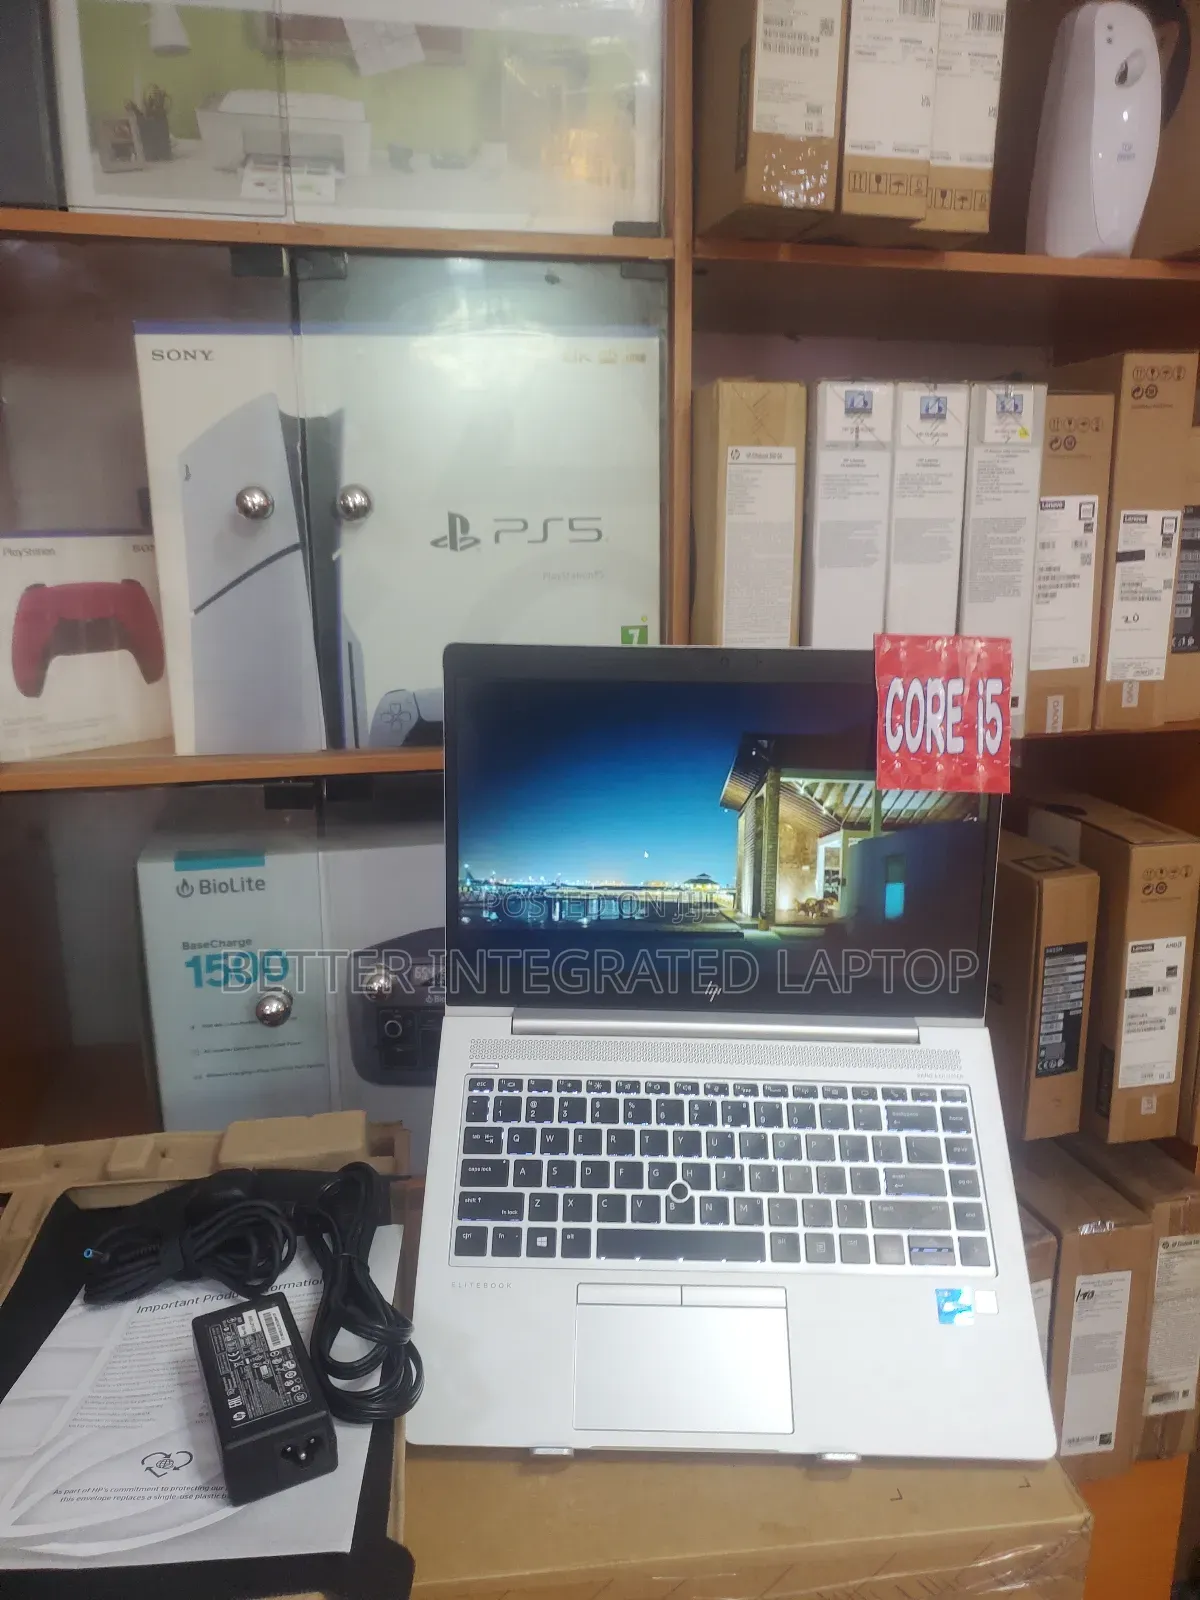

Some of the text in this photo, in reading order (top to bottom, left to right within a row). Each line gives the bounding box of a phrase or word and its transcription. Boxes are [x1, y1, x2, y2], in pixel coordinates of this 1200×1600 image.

[151, 349, 214, 361] SONY
[493, 517, 603, 544] PS5
[885, 676, 1003, 756] CORE i5
[199, 877, 266, 895] BioLite
[182, 937, 253, 951] BaseCharge
[513, 1134, 520, 1142] Q
[578, 1135, 583, 1143] E
[610, 1135, 616, 1143] R
[644, 1135, 650, 1143] T
[678, 1136, 684, 1144] Y
[711, 1138, 718, 1146] U
[552, 1167, 558, 1175] S
[585, 1167, 592, 1175] D
[619, 1168, 625, 1176] F
[652, 1169, 659, 1177] G
[686, 1170, 693, 1178] H
[534, 1199, 541, 1207] Z
[567, 1199, 574, 1207] X
[601, 1199, 608, 1207] C
[636, 1200, 643, 1208] V
[705, 1203, 713, 1211] N
[739, 1204, 748, 1212] M
[451, 1281, 512, 1289] ELITEBOOK
[136, 1278, 323, 1314] Important Produ ormatio
[169, 1485, 209, 1493] protecting
[194, 1492, 220, 1500] plastic
